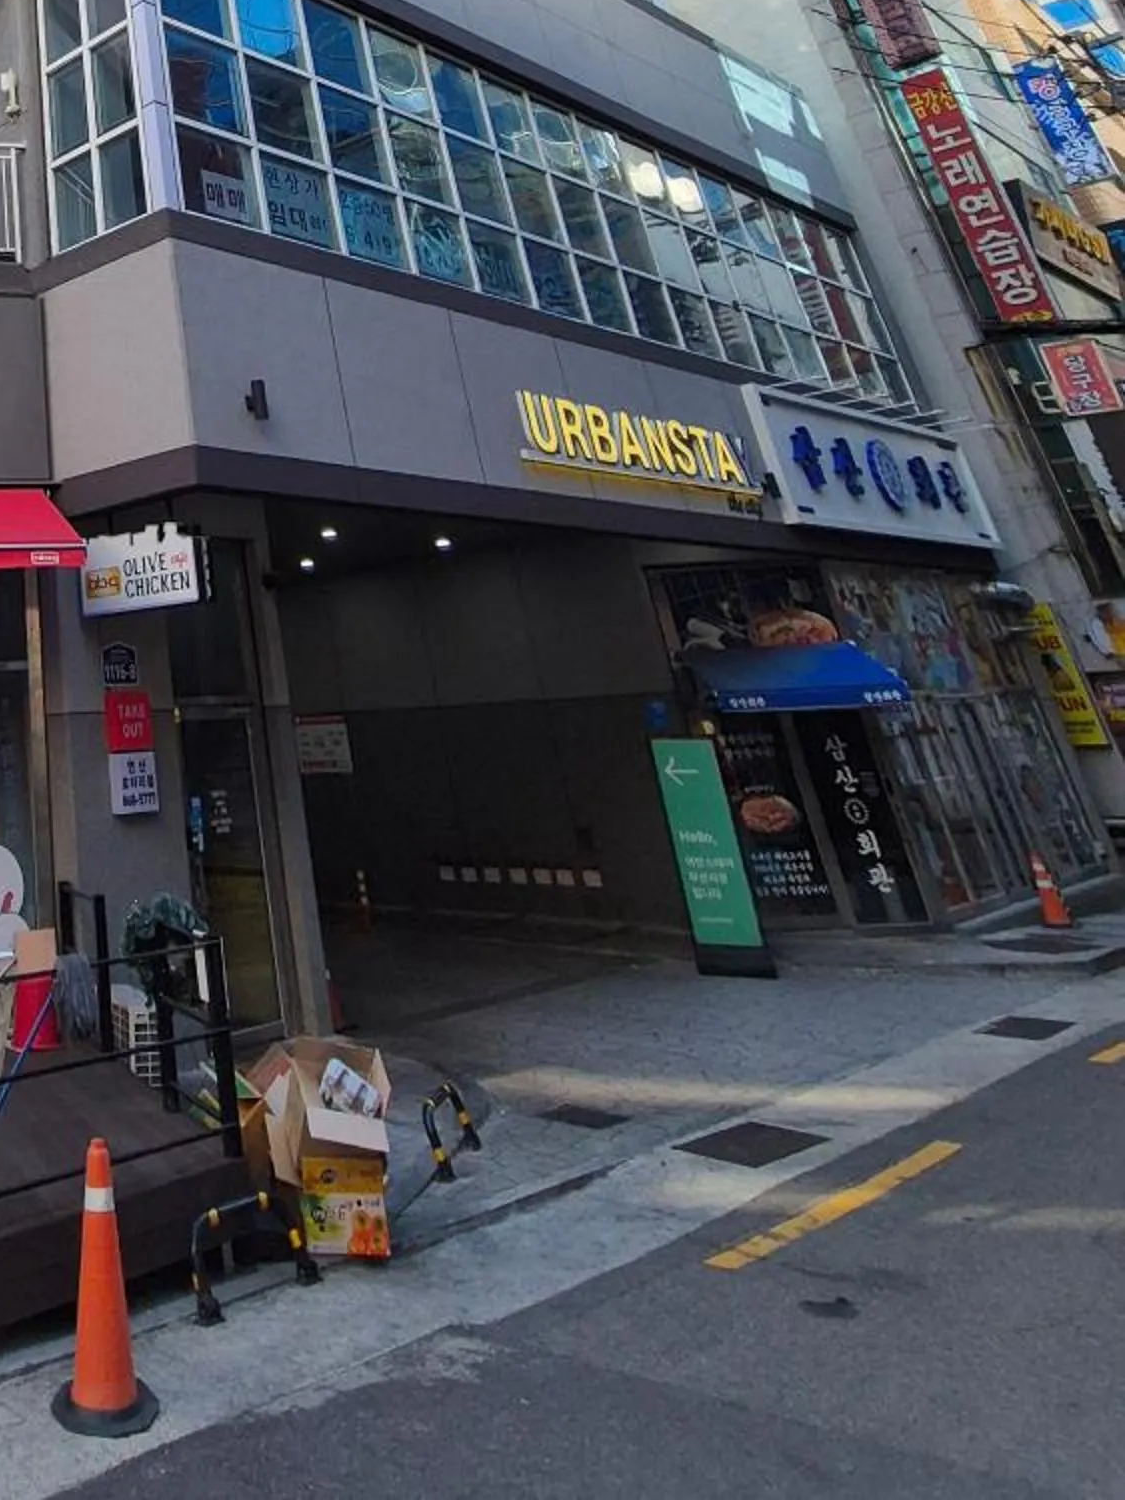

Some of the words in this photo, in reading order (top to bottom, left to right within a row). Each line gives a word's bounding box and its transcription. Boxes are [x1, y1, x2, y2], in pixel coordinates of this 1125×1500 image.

[926, 124, 1038, 304] 노래연습장
[123, 552, 168, 577] OLIVE
[124, 571, 190, 598] CHICKEN
[118, 705, 145, 719] TAKE
[123, 723, 144, 739] OUT
